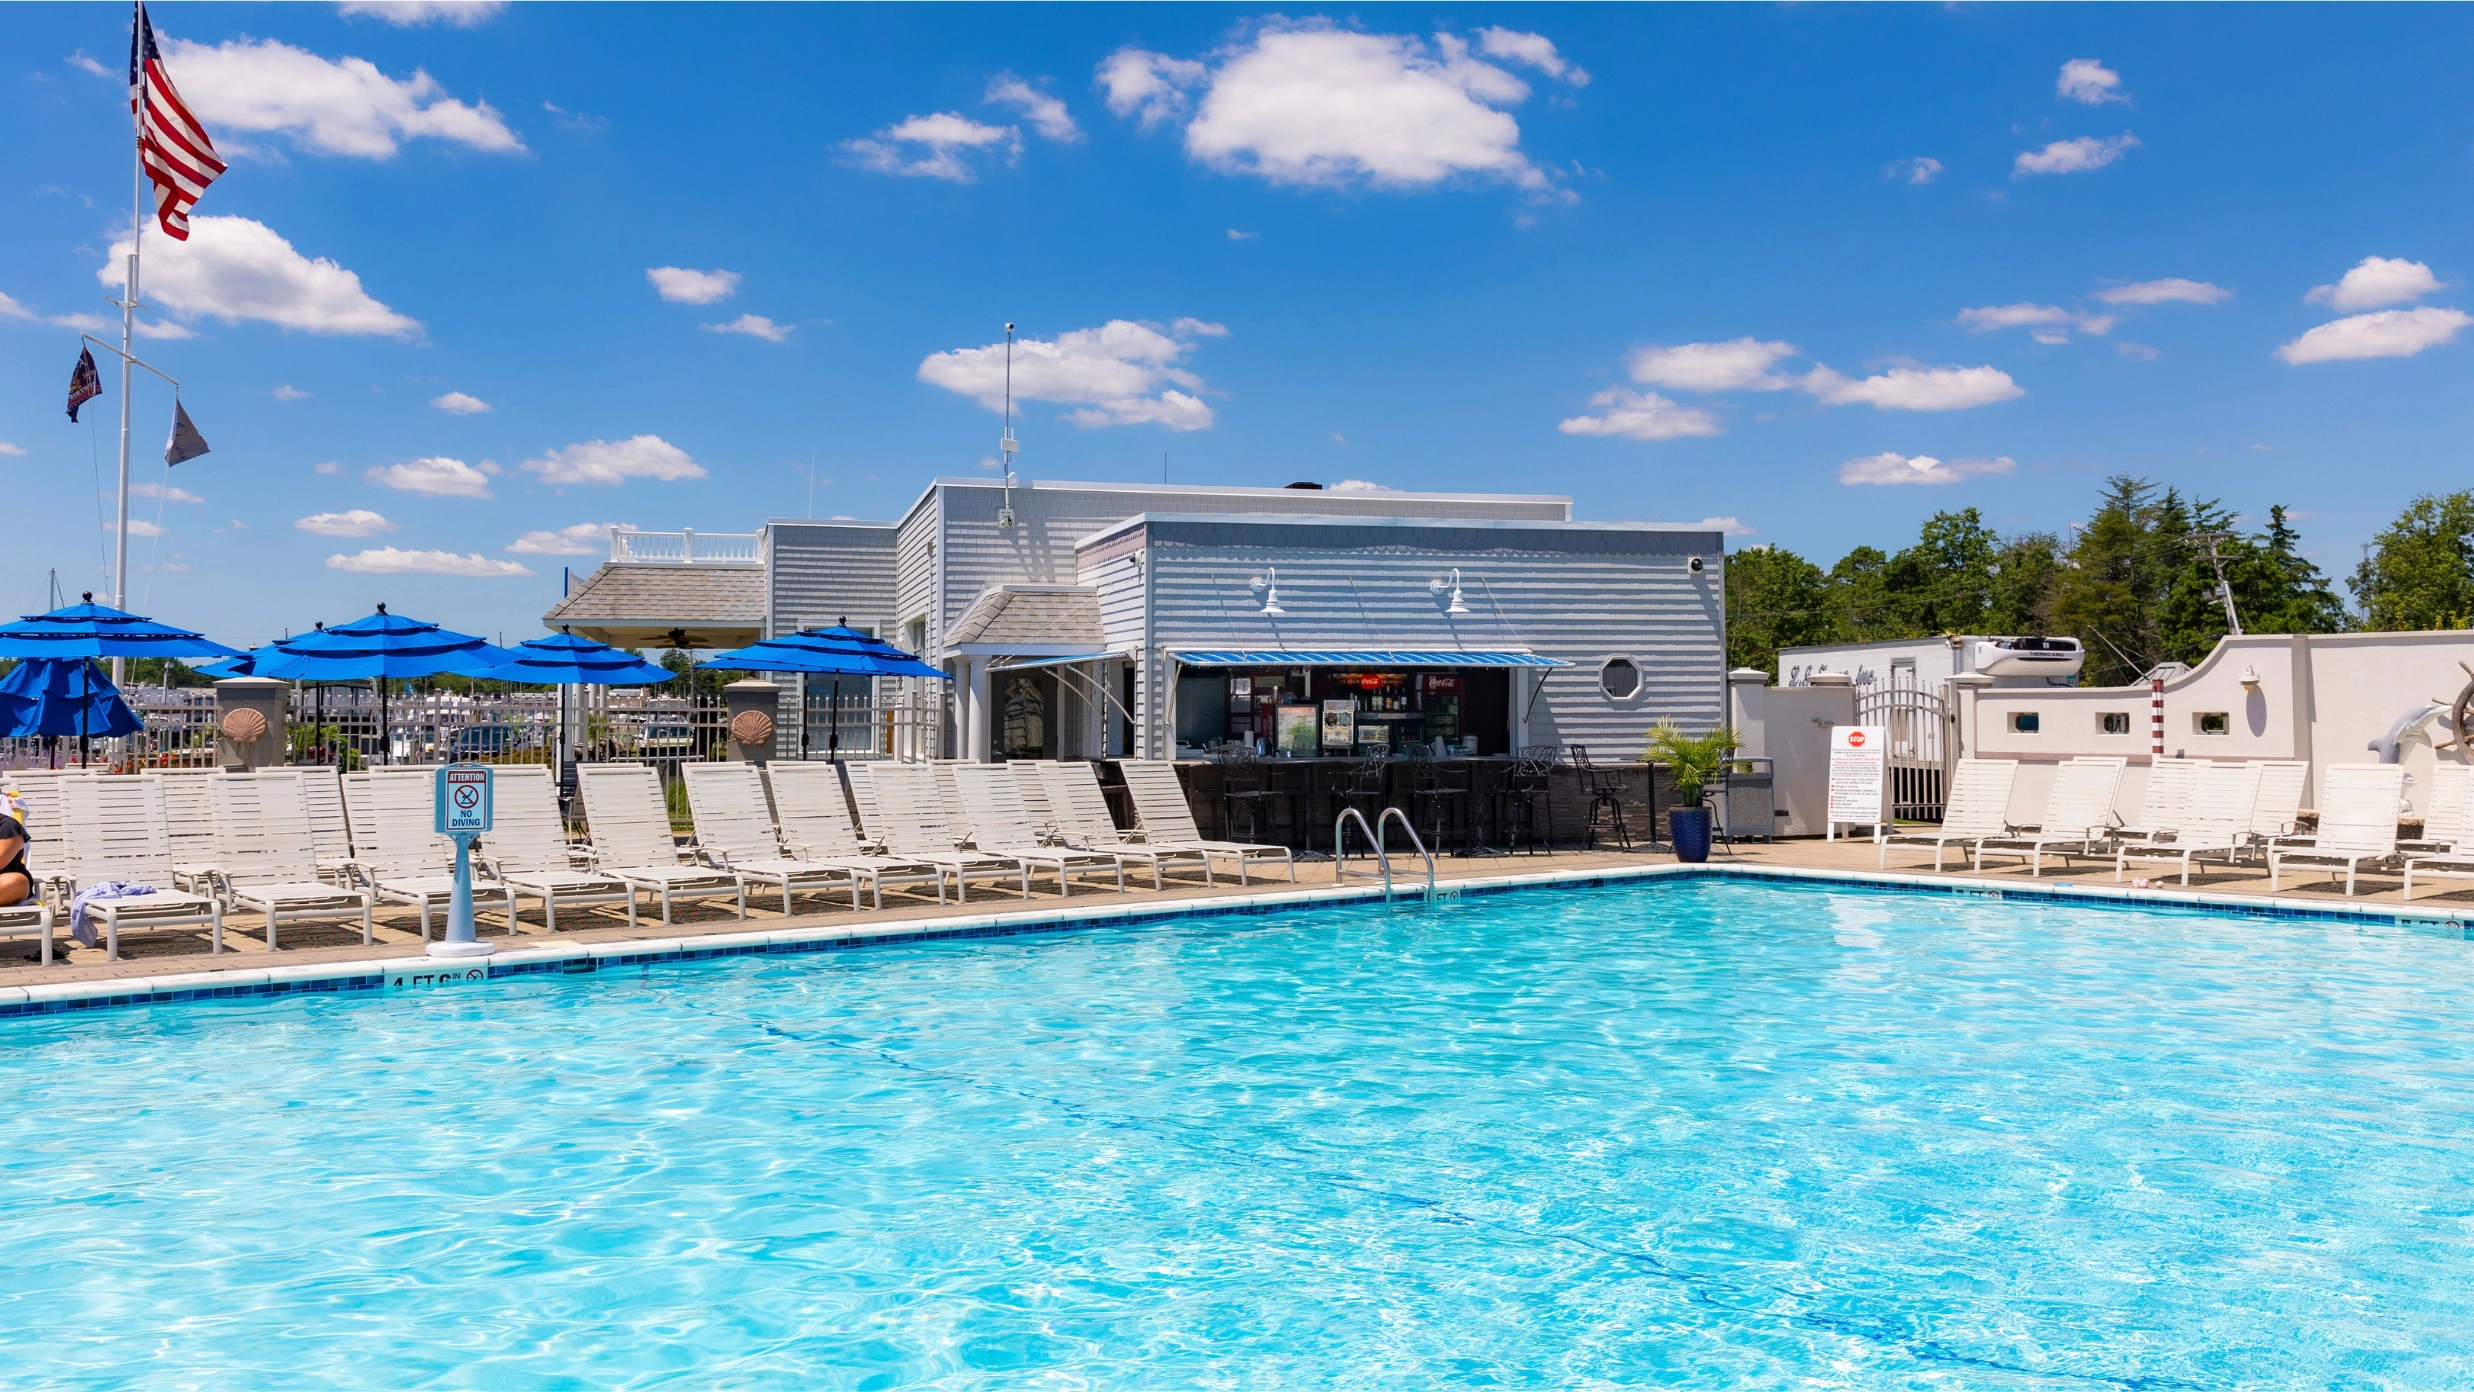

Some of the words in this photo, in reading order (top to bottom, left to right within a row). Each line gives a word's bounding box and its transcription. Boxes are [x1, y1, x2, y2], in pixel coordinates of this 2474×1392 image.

[1429, 679, 1455, 687] Coca-Cola
[449, 773, 485, 782] ATTENTION
[460, 810, 473, 818] NO
[452, 818, 481, 827] DIVING
